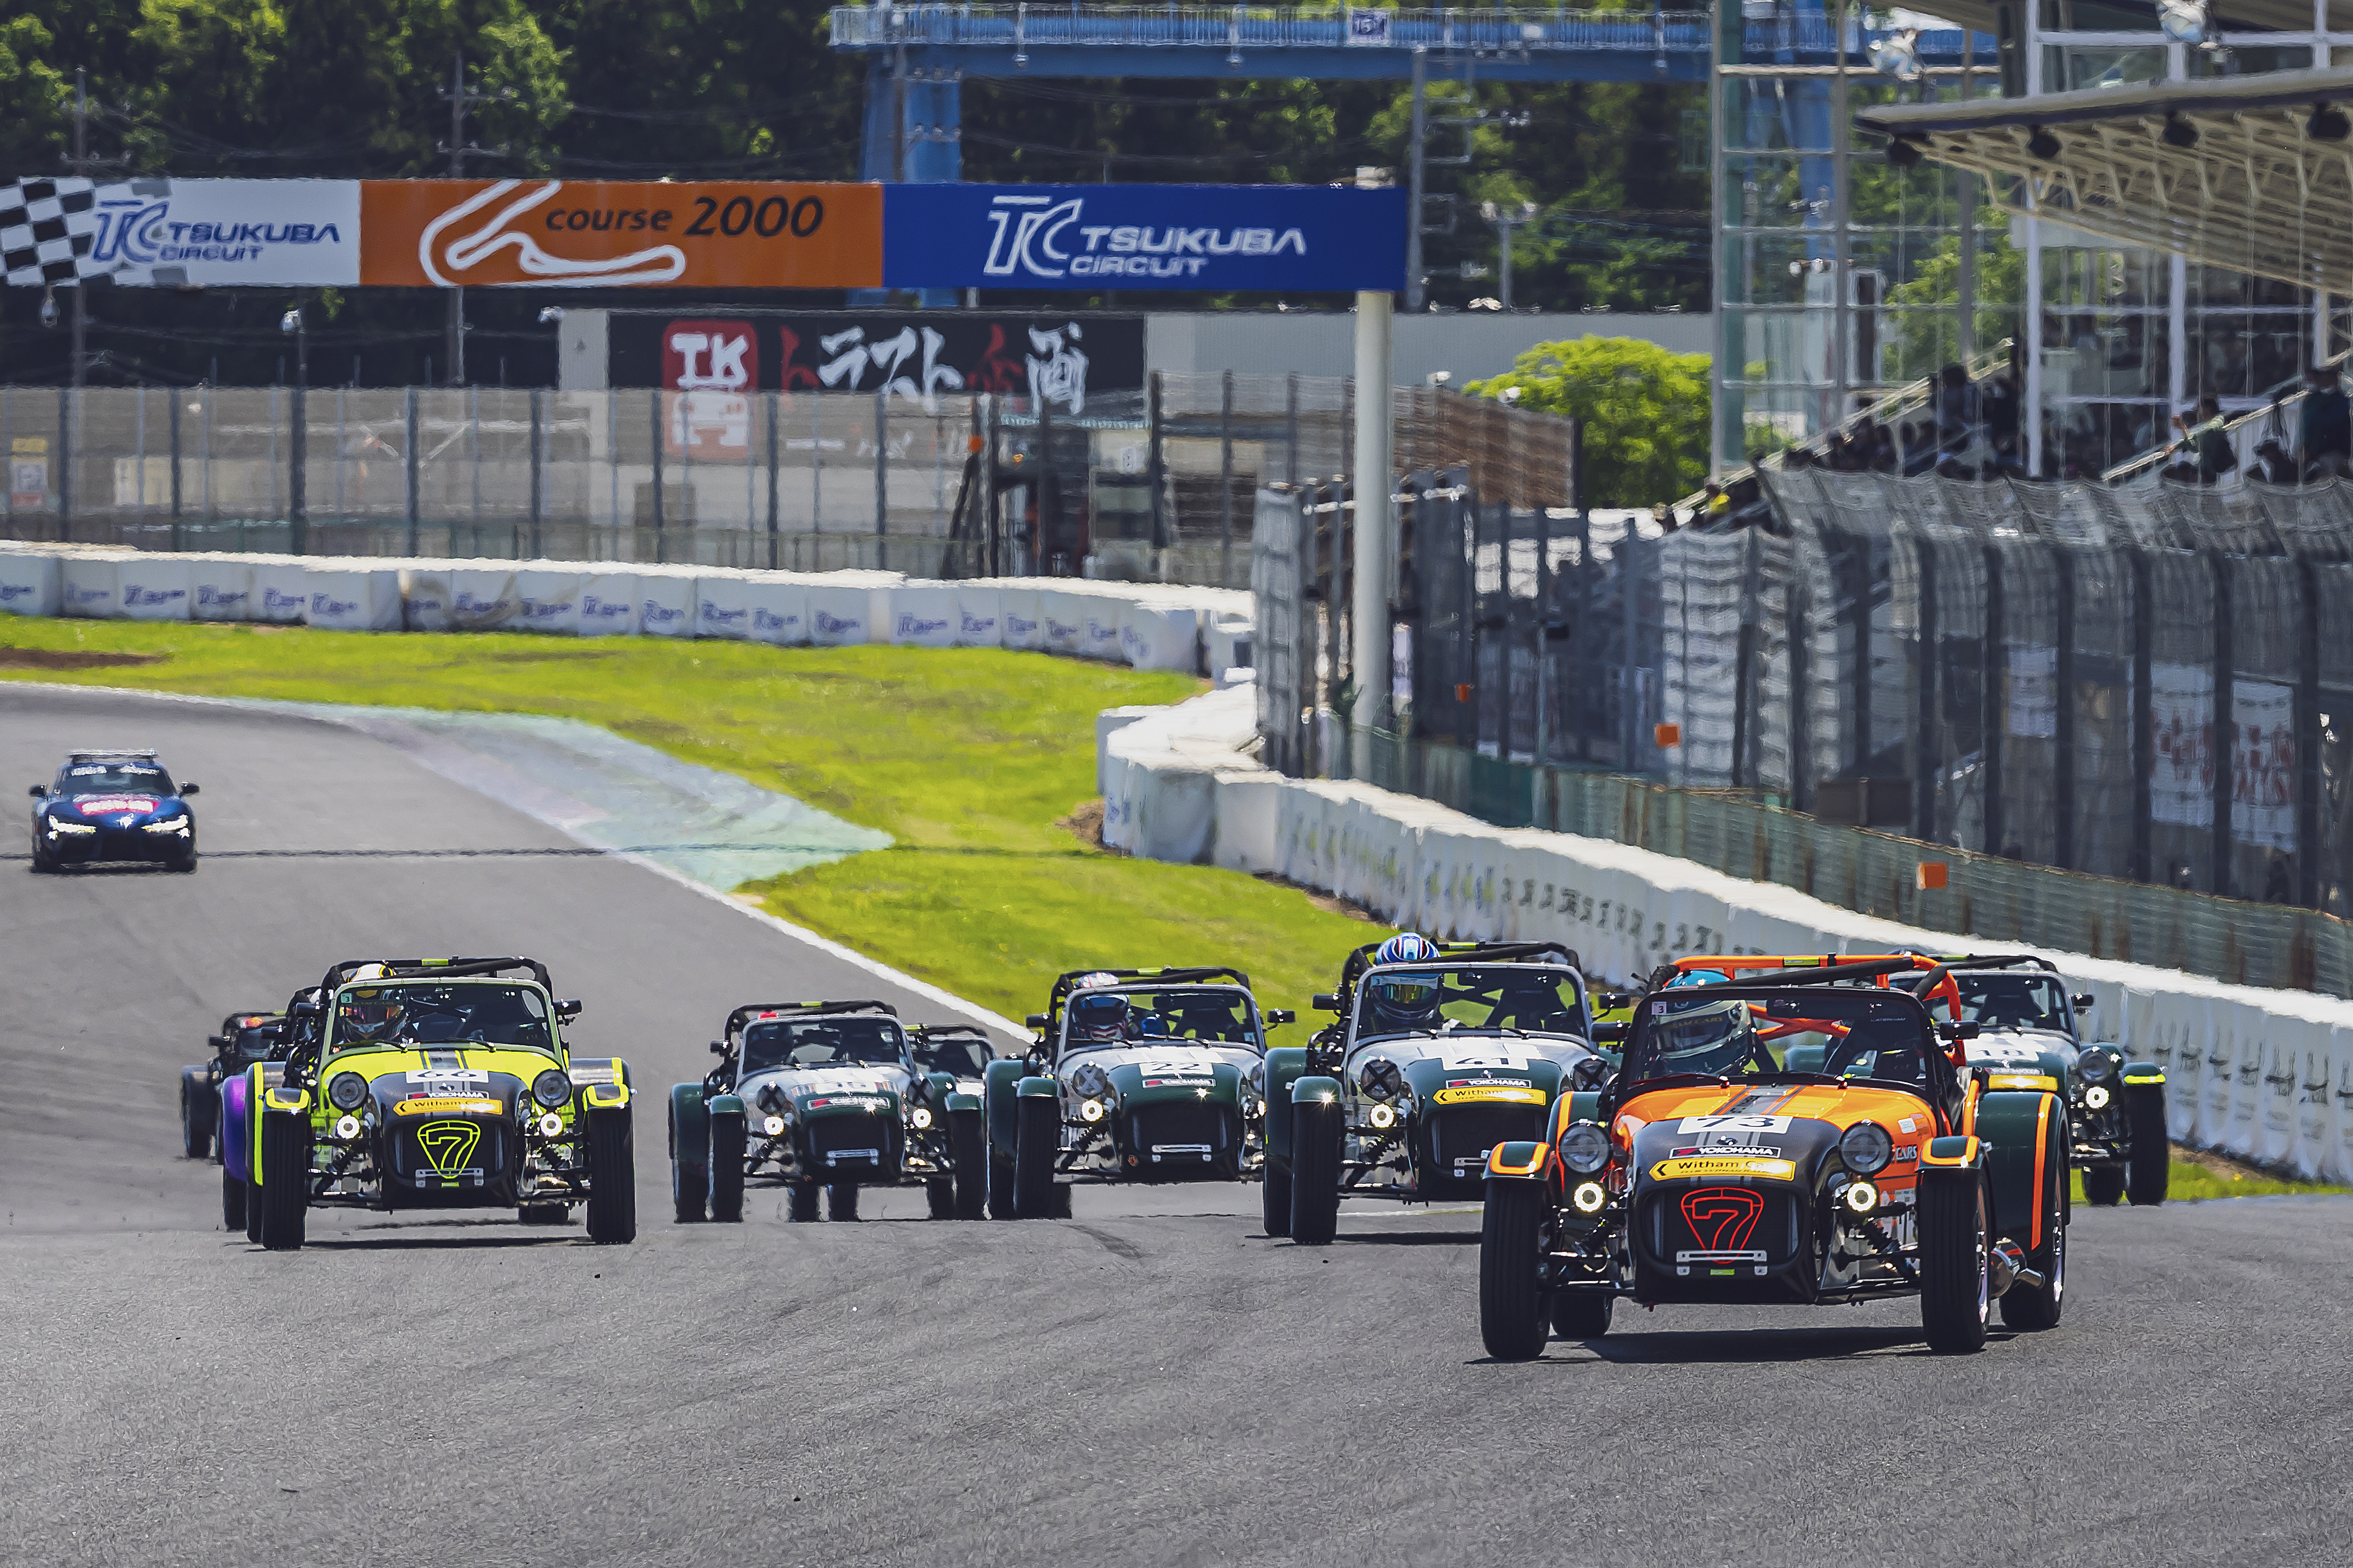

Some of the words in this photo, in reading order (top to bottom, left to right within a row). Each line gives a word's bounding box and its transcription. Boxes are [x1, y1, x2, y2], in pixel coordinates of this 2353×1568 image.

[545, 206, 673, 232] course
[683, 195, 824, 238] 2000
[168, 222, 340, 243] TSUKUBA
[1079, 225, 1307, 256] TSUKUBA
[160, 245, 264, 262] CIRCUIT
[1069, 256, 1209, 278] CIRCUIT
[1151, 1063, 1201, 1071] 22
[1455, 1057, 1509, 1065] 41
[1697, 1117, 1775, 1128] 73
[1698, 1147, 1773, 1155] YOKOHAMA
[1896, 1145, 1917, 1160] CARS
[1678, 1160, 1739, 1170] Witham
